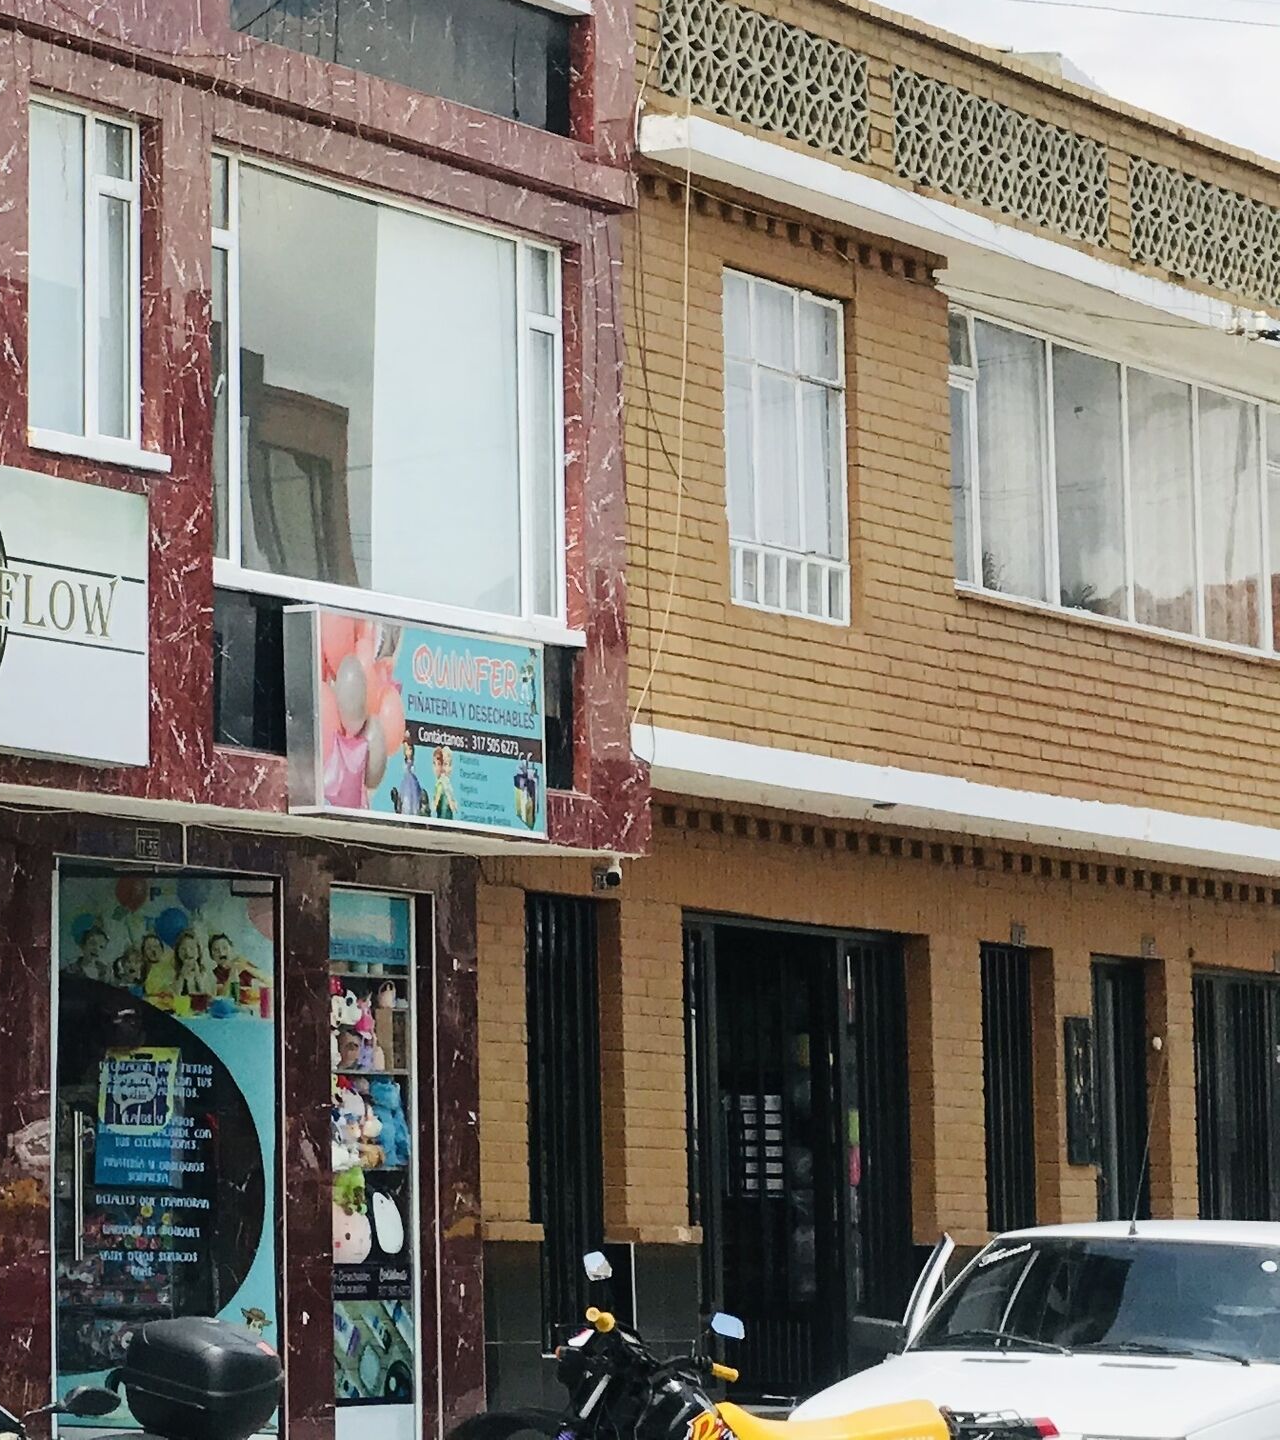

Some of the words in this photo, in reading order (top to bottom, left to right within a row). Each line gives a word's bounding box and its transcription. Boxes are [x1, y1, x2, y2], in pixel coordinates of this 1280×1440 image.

[412, 643, 519, 702] QUINFER
[460, 702, 467, 721] Y
[468, 703, 536, 731] DESECHABLES
[472, 734, 486, 751] 317
